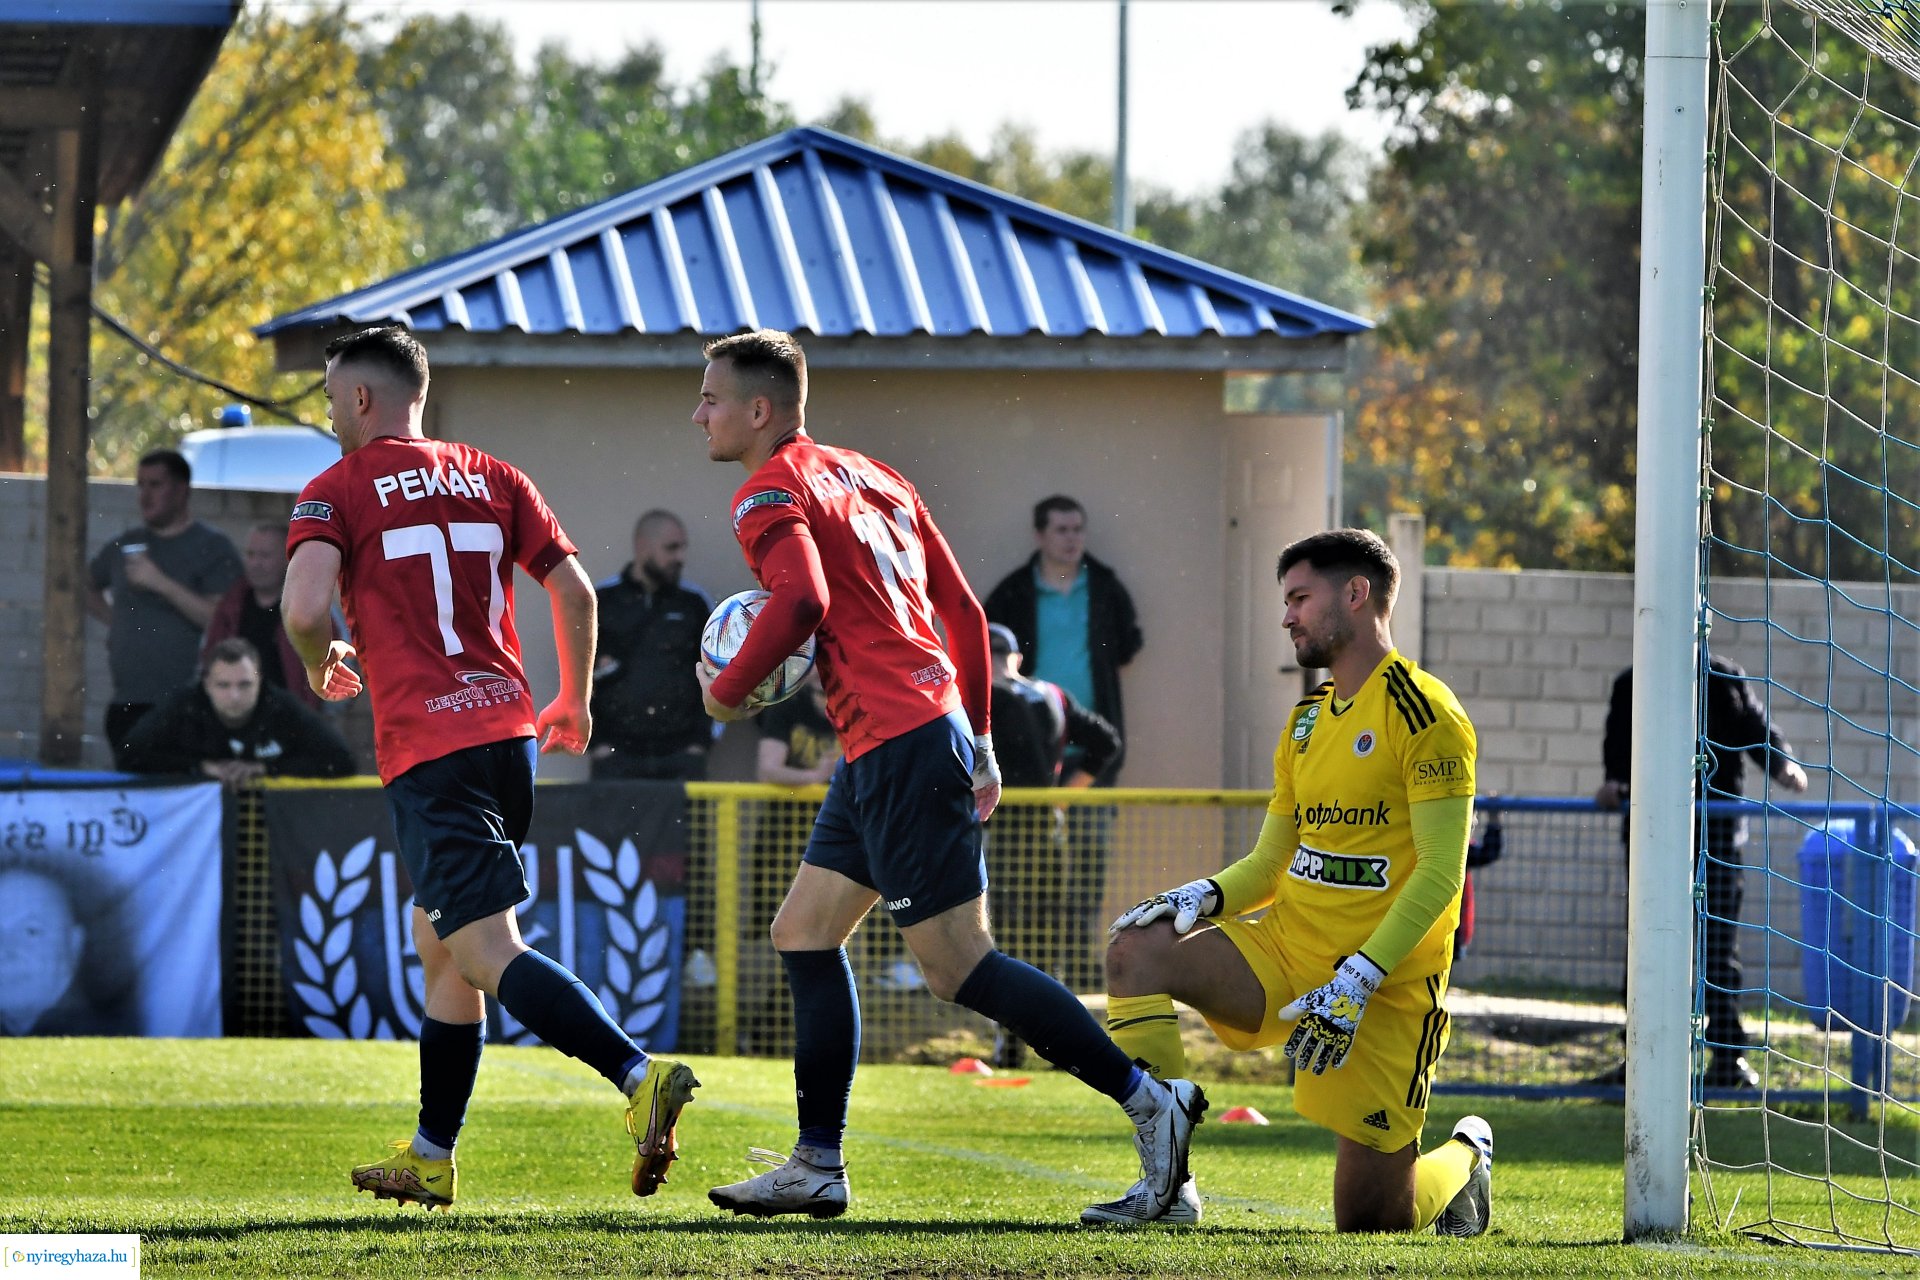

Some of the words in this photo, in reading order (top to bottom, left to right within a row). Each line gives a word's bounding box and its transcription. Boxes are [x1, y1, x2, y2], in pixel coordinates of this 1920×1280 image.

[373, 463, 491, 508] PEKÁR
[382, 522, 504, 656] 77
[849, 507, 936, 640] 14
[1418, 761, 1457, 779] SMP
[1306, 800, 1391, 830] otpbank
[1363, 1117, 1390, 1131] adidas
